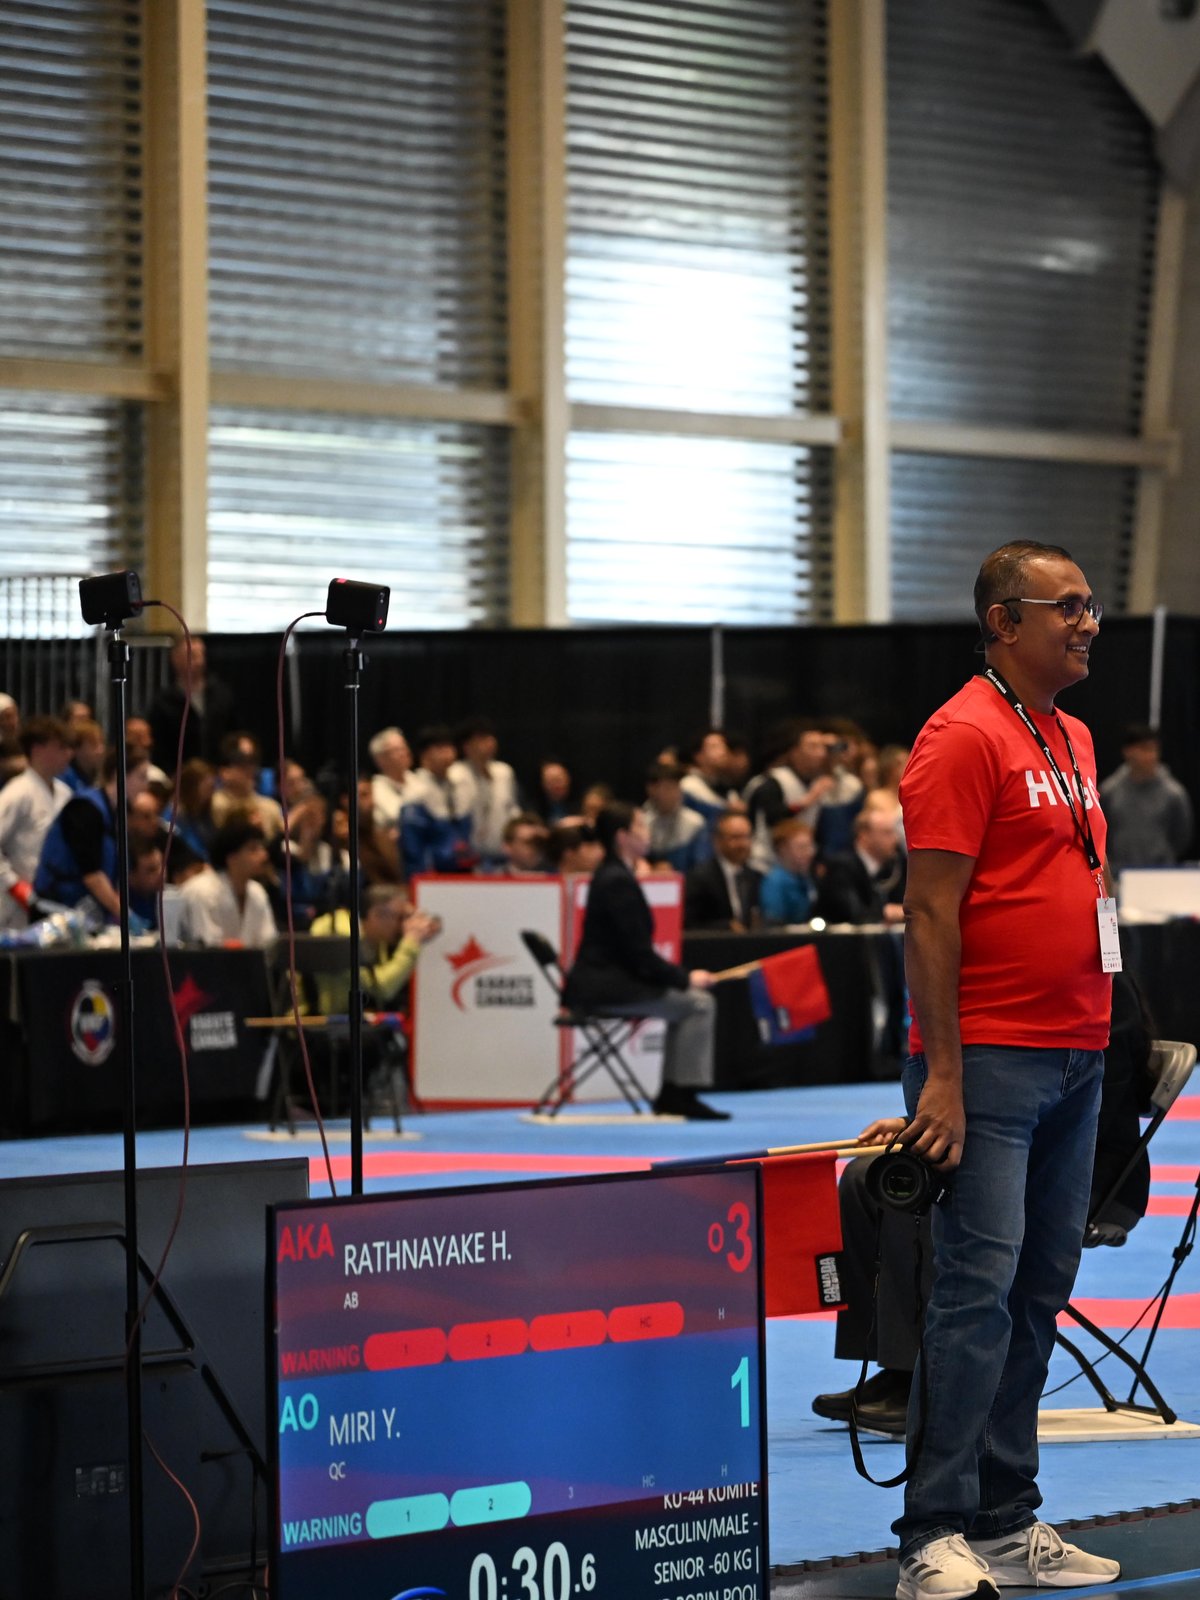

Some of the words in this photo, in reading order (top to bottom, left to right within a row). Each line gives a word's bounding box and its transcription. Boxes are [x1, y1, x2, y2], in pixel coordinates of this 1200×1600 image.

[277, 1223, 335, 1263] AKA
[343, 1232, 486, 1276] RATHNAYAKE
[491, 1230, 512, 1262] H.
[727, 1202, 753, 1272] 3
[343, 1291, 359, 1309] AB
[281, 1344, 361, 1375] WARNING
[486, 1333, 492, 1347] 2
[640, 1316, 653, 1329] HC
[718, 1307, 725, 1320] H
[731, 1356, 751, 1428] 1
[279, 1393, 319, 1433] AO
[329, 1410, 376, 1447] MIRI
[382, 1407, 401, 1439] Y.
[329, 1461, 346, 1481] QC
[283, 1512, 363, 1545] WARNING
[406, 1510, 411, 1522] 1
[488, 1498, 494, 1511] 2
[568, 1486, 574, 1499] 3
[642, 1474, 656, 1489] HC
[721, 1464, 728, 1478] H
[708, 1481, 759, 1504] KUMITE
[635, 1513, 750, 1551] MASCULIN/MALE
[654, 1556, 705, 1585] SENIOR
[708, 1552, 730, 1575] -60
[733, 1548, 752, 1572] KG
